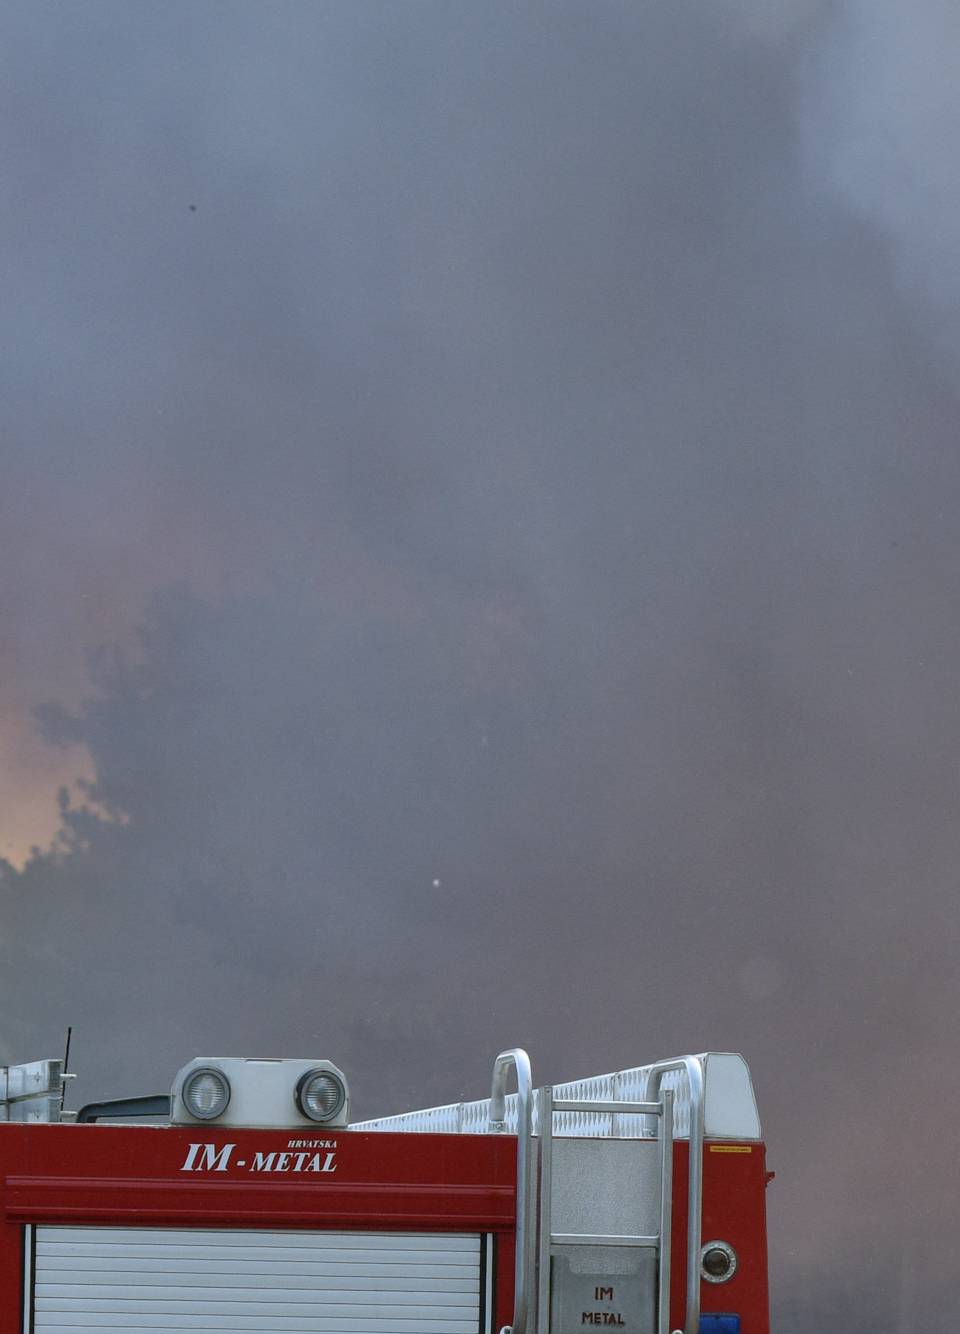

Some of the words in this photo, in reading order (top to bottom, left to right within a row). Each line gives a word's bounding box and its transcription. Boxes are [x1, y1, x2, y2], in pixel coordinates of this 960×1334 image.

[288, 1139, 337, 1149] HRVATSKA
[179, 1143, 237, 1172] IM
[249, 1151, 338, 1173] METAL
[595, 1286, 614, 1301] IM
[581, 1311, 625, 1326] METAL
